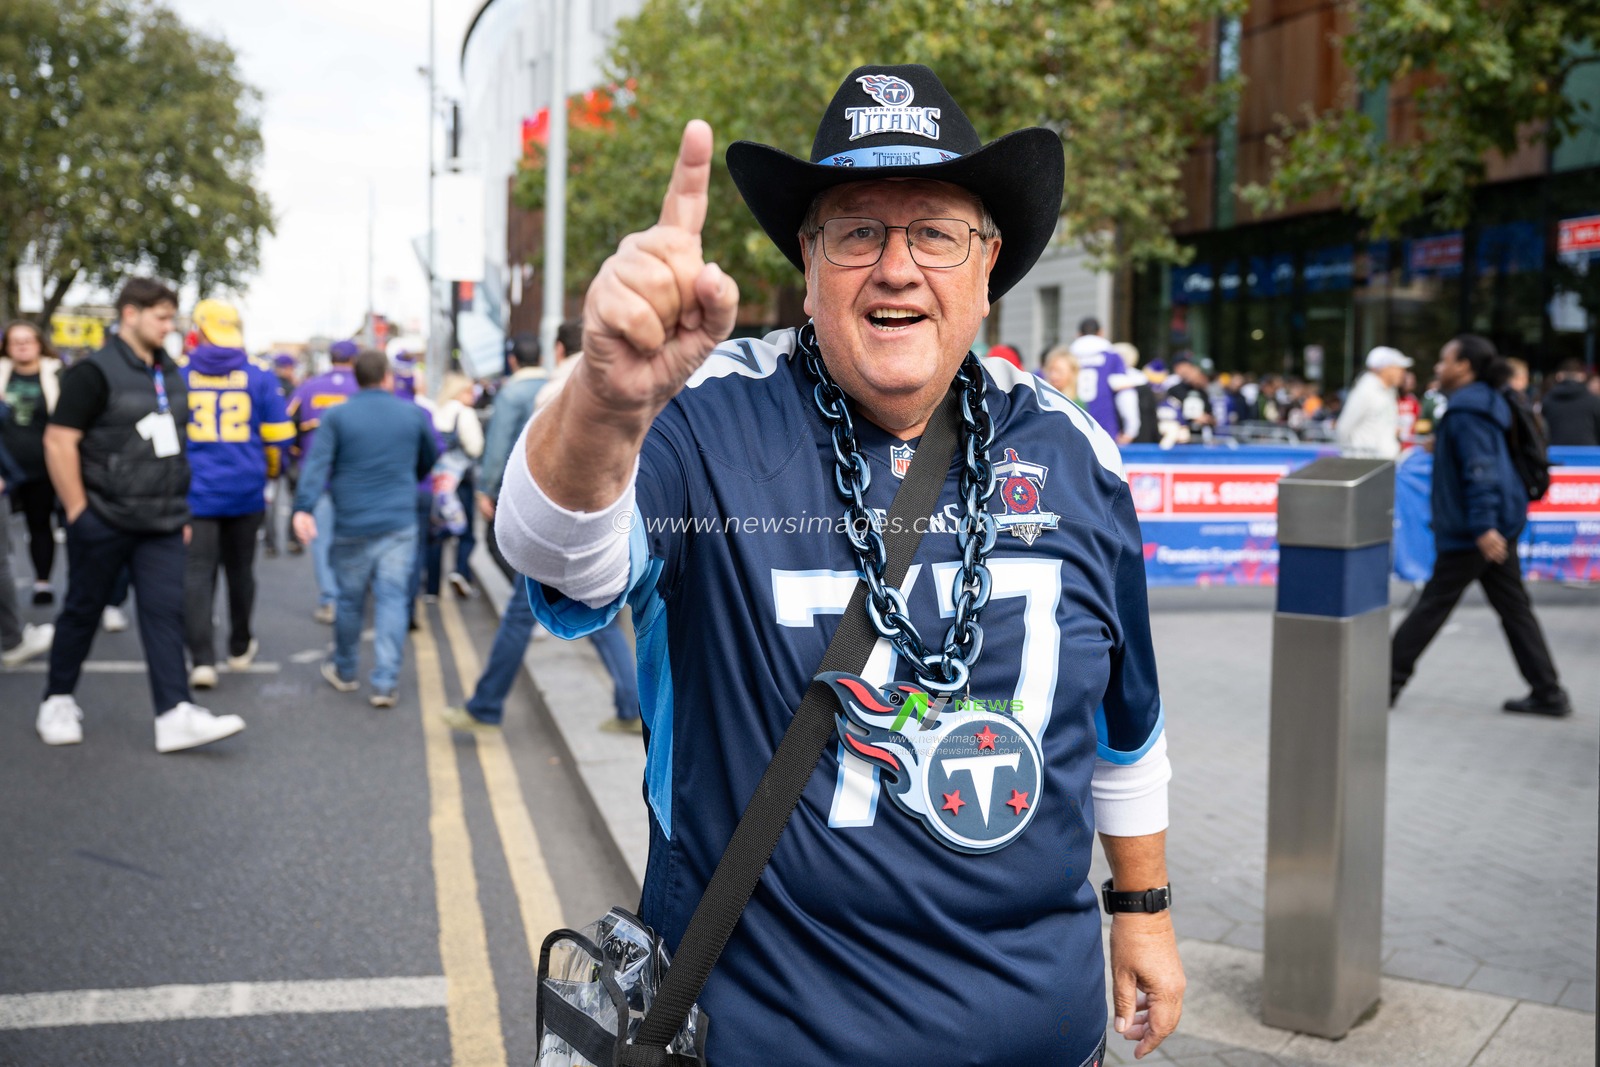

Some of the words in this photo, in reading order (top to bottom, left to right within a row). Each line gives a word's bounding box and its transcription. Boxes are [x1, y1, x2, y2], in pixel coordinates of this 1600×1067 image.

[845, 107, 940, 140] TITANS
[873, 151, 920, 167] TITANS
[186, 390, 251, 442] 32
[1173, 481, 1218, 505] NFL
